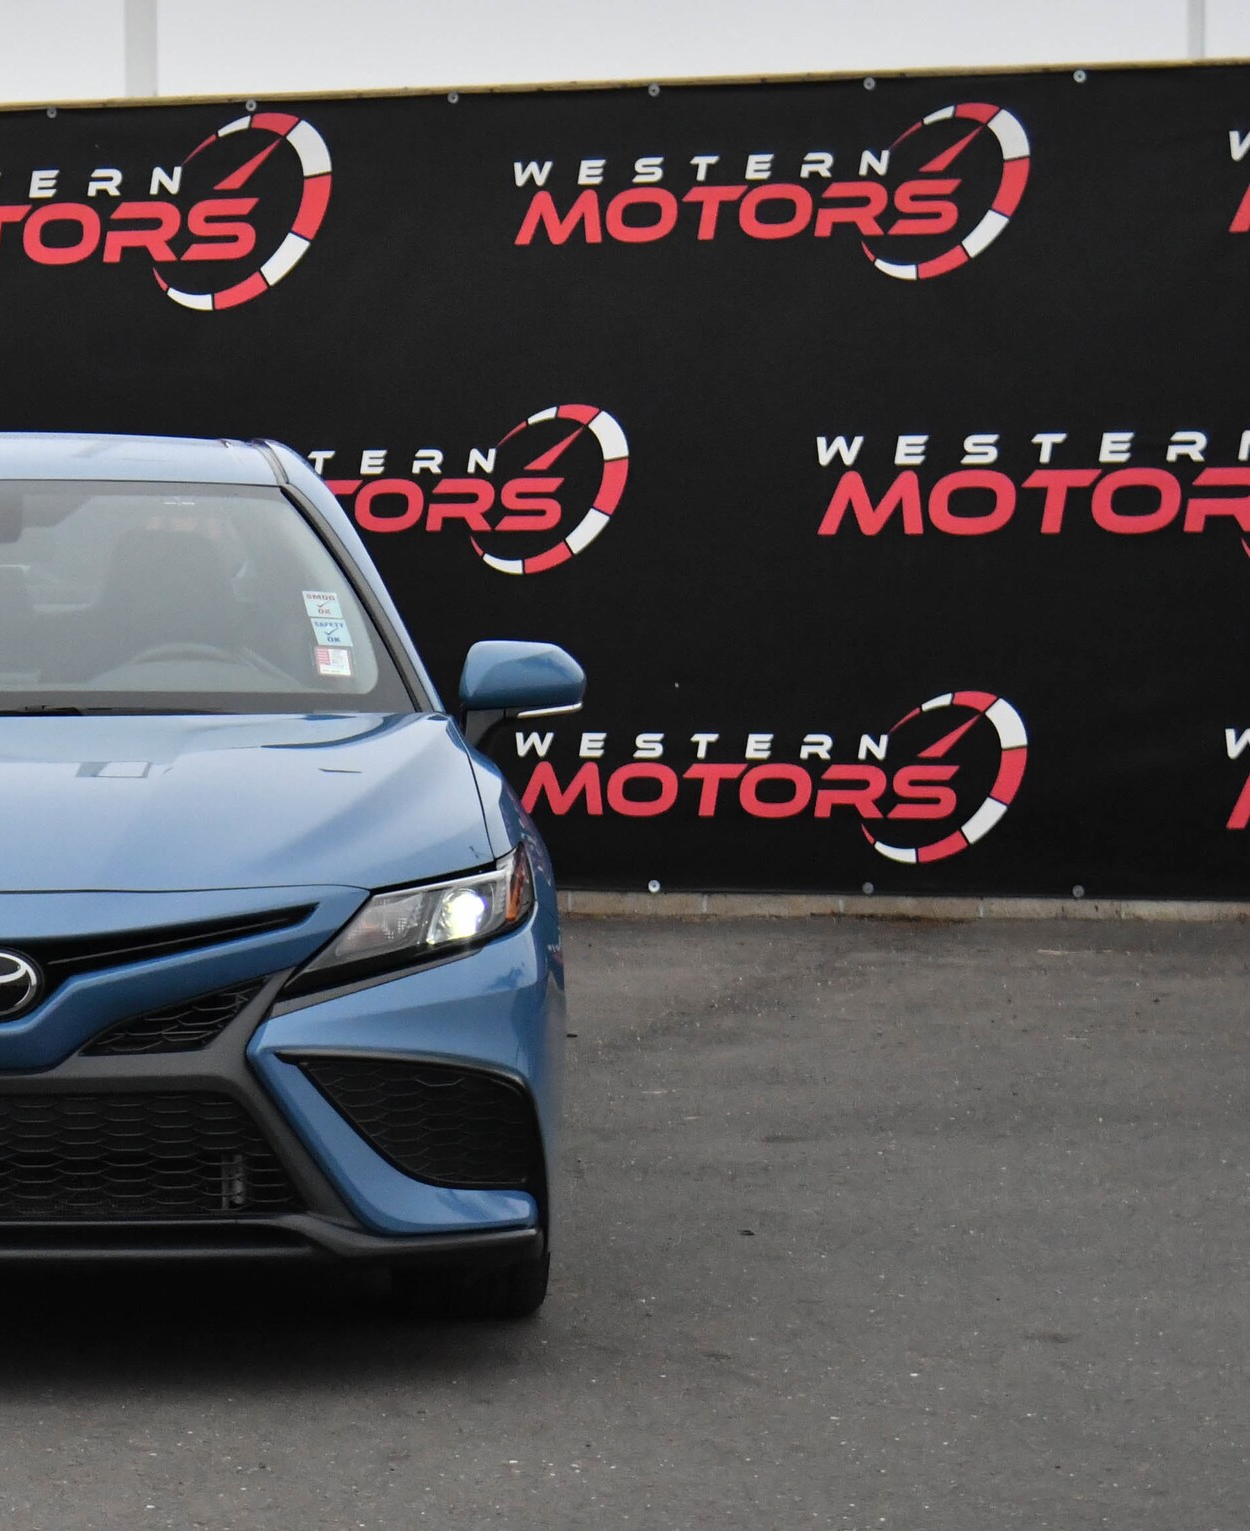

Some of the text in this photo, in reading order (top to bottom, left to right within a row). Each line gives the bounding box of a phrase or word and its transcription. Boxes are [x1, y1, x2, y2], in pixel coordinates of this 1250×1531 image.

[514, 149, 890, 187] WESTERN
[515, 178, 961, 246] MOTORS
[516, 731, 889, 760] WESTERN
[522, 761, 960, 820] MOTORS
